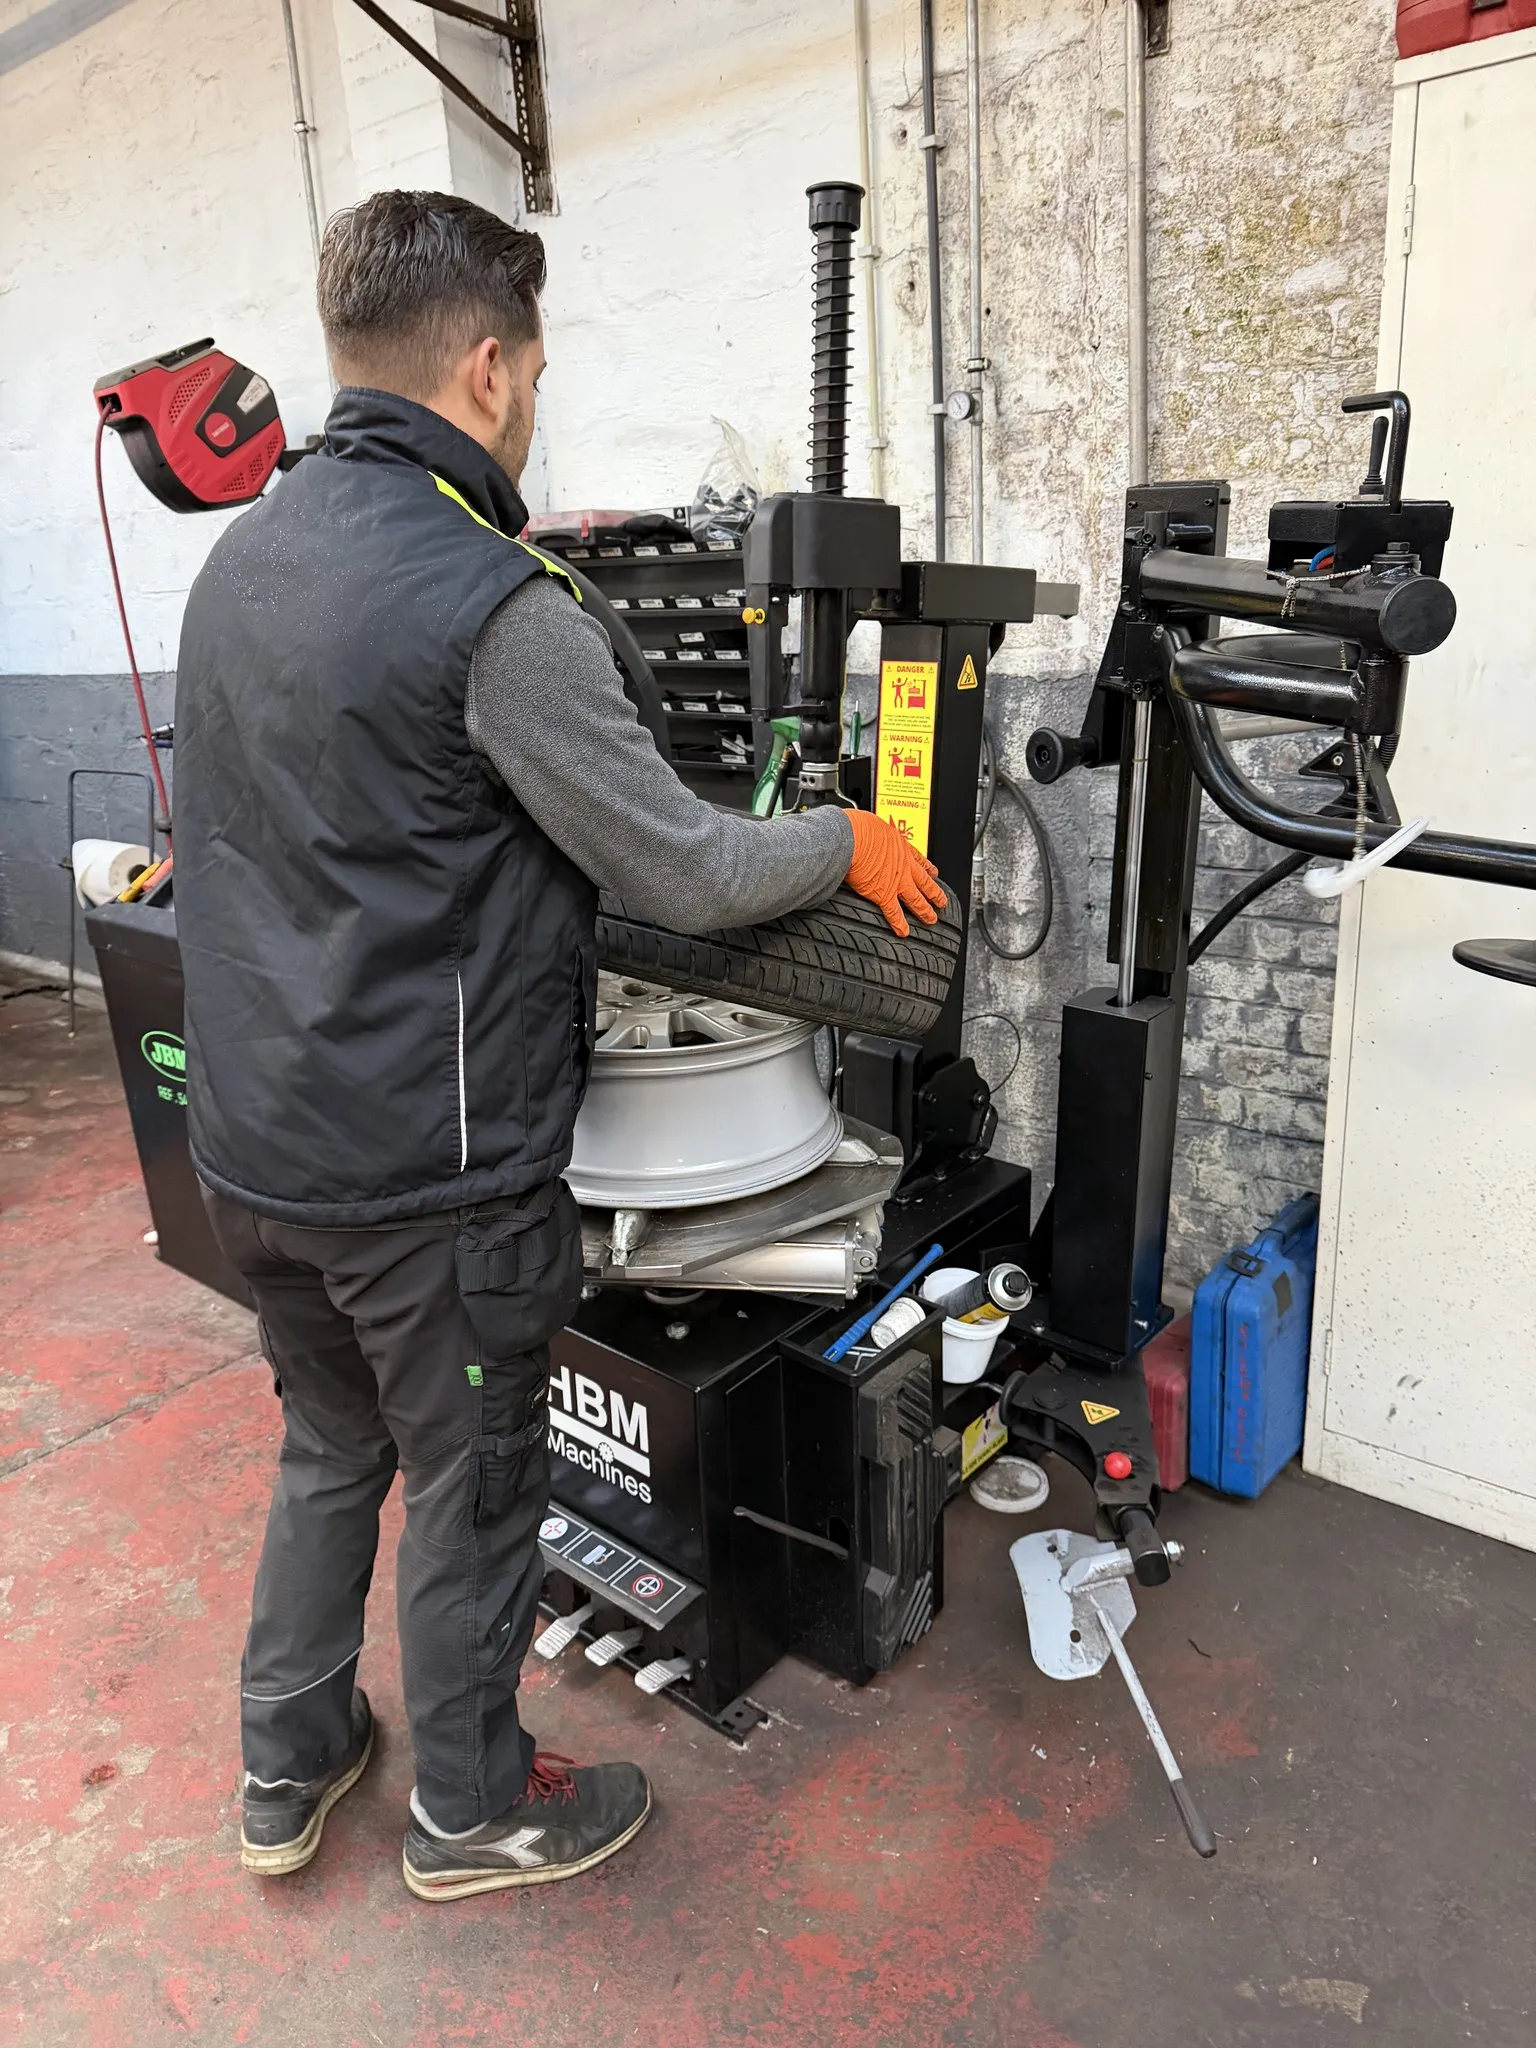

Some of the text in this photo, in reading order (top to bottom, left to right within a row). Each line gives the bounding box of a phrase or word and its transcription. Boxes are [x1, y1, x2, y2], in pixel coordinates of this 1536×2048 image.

[896, 665, 925, 674] DANGER
[889, 734, 923, 744] WARNING
[886, 798, 920, 809] WARNING
[547, 1365, 650, 1454] HBM
[547, 1428, 652, 1504] Machines
